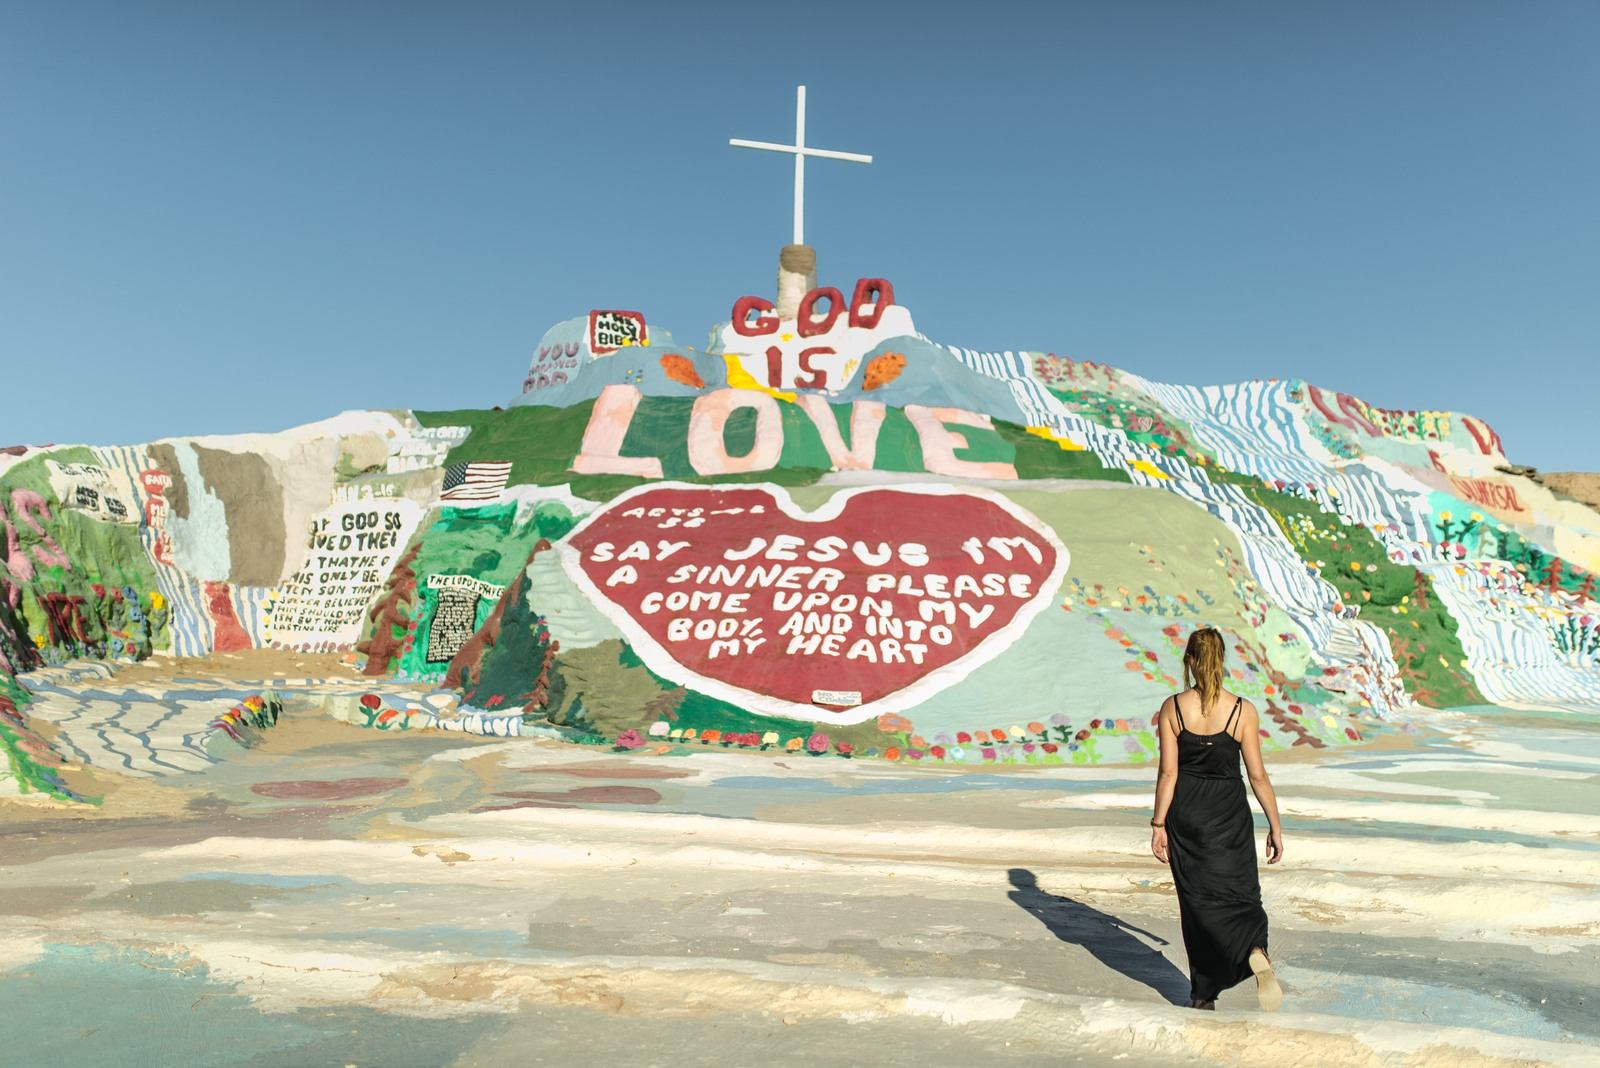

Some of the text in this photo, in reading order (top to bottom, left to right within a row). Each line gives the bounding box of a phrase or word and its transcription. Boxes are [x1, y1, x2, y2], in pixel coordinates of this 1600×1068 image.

[732, 277, 895, 338] GOD
[598, 321, 637, 341] HOLY
[598, 332, 623, 346] BIB
[538, 340, 580, 362] YOU
[765, 346, 836, 389] IS
[567, 384, 1019, 479] LOVE
[341, 511, 379, 532] GOD
[384, 511, 402, 531] SO
[591, 541, 691, 563] SAY
[724, 535, 930, 568] JESUS
[318, 585, 346, 596] SON
[320, 570, 358, 584] ONLY
[430, 575, 449, 586] THE
[607, 565, 1034, 598] A SINNER PLEASE
[640, 592, 996, 629] COME UPON MY
[779, 611, 853, 636] AND
[865, 616, 953, 645] INTO
[708, 634, 928, 664] MY HEART
